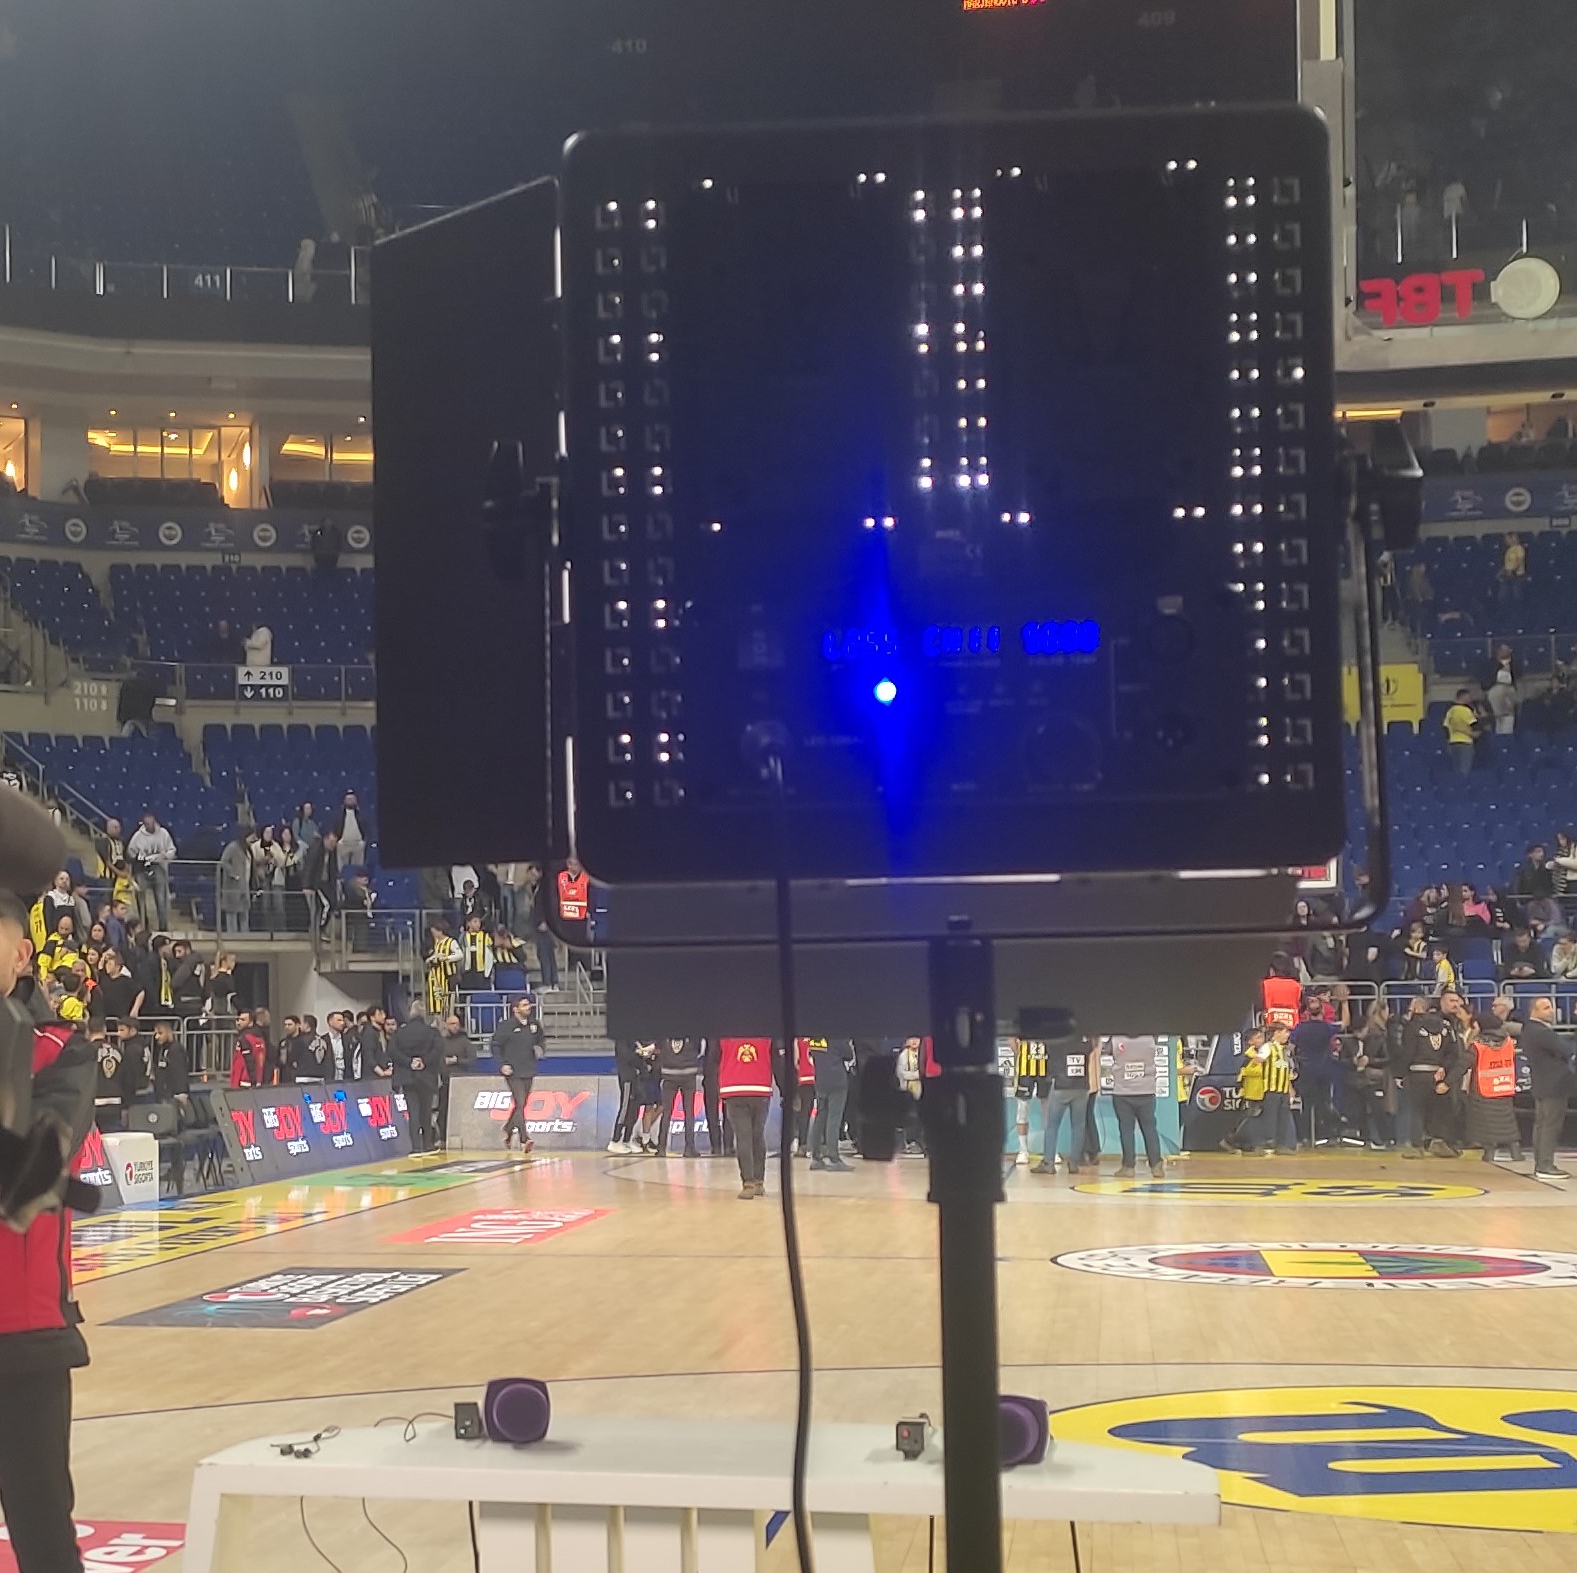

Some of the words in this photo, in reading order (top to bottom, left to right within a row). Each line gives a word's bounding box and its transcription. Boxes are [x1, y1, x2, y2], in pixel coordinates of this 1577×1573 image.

[610, 38, 648, 54] 410
[194, 273, 221, 289] 411
[259, 670, 283, 681] 210
[74, 682, 99, 695] 210
[259, 687, 284, 699] 110
[75, 698, 100, 711] 110
[474, 1092, 512, 1109] BIG
[274, 1104, 304, 1140] JOY
[320, 1100, 347, 1134] JOY
